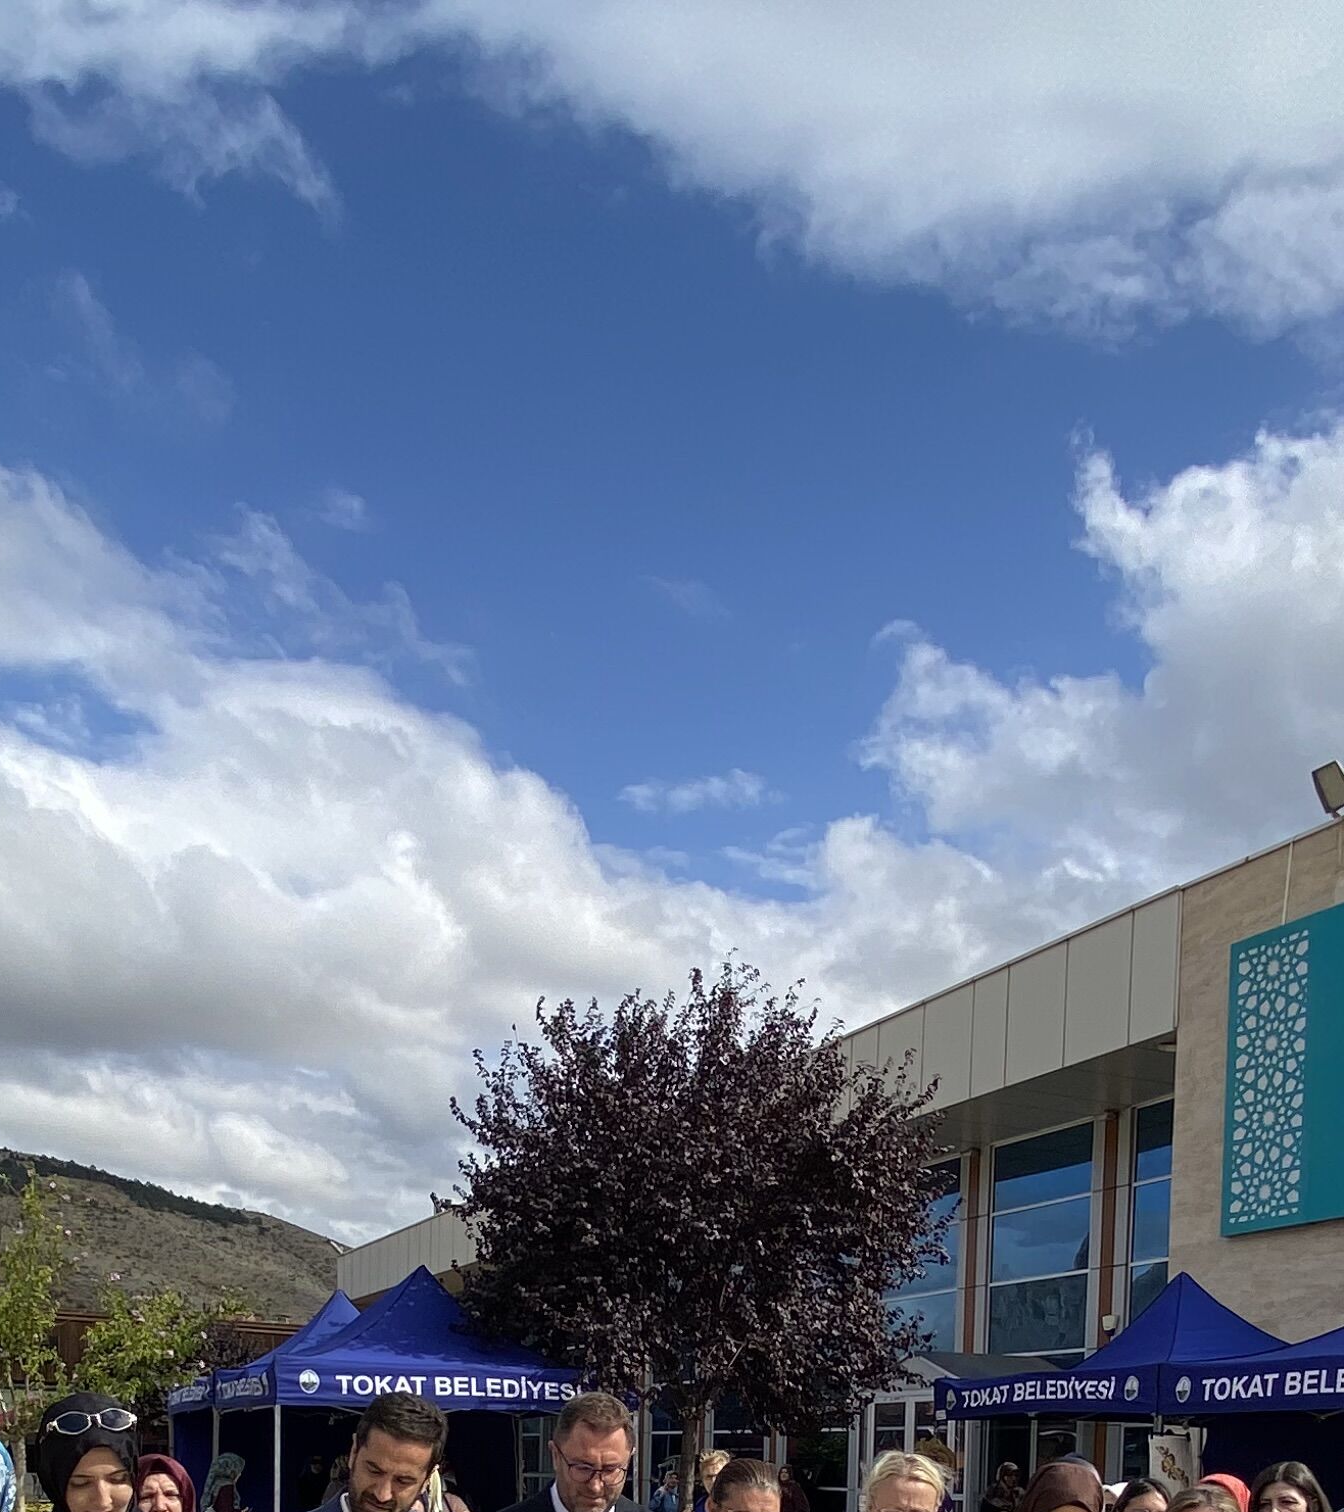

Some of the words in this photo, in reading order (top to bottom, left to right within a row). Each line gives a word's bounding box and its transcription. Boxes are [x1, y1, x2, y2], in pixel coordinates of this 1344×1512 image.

[335, 1375, 427, 1396] TOKAT
[961, 1385, 1010, 1408] TOKAT
[1012, 1376, 1116, 1402] BELEDİYESİ
[1201, 1373, 1279, 1401] TOKAT
